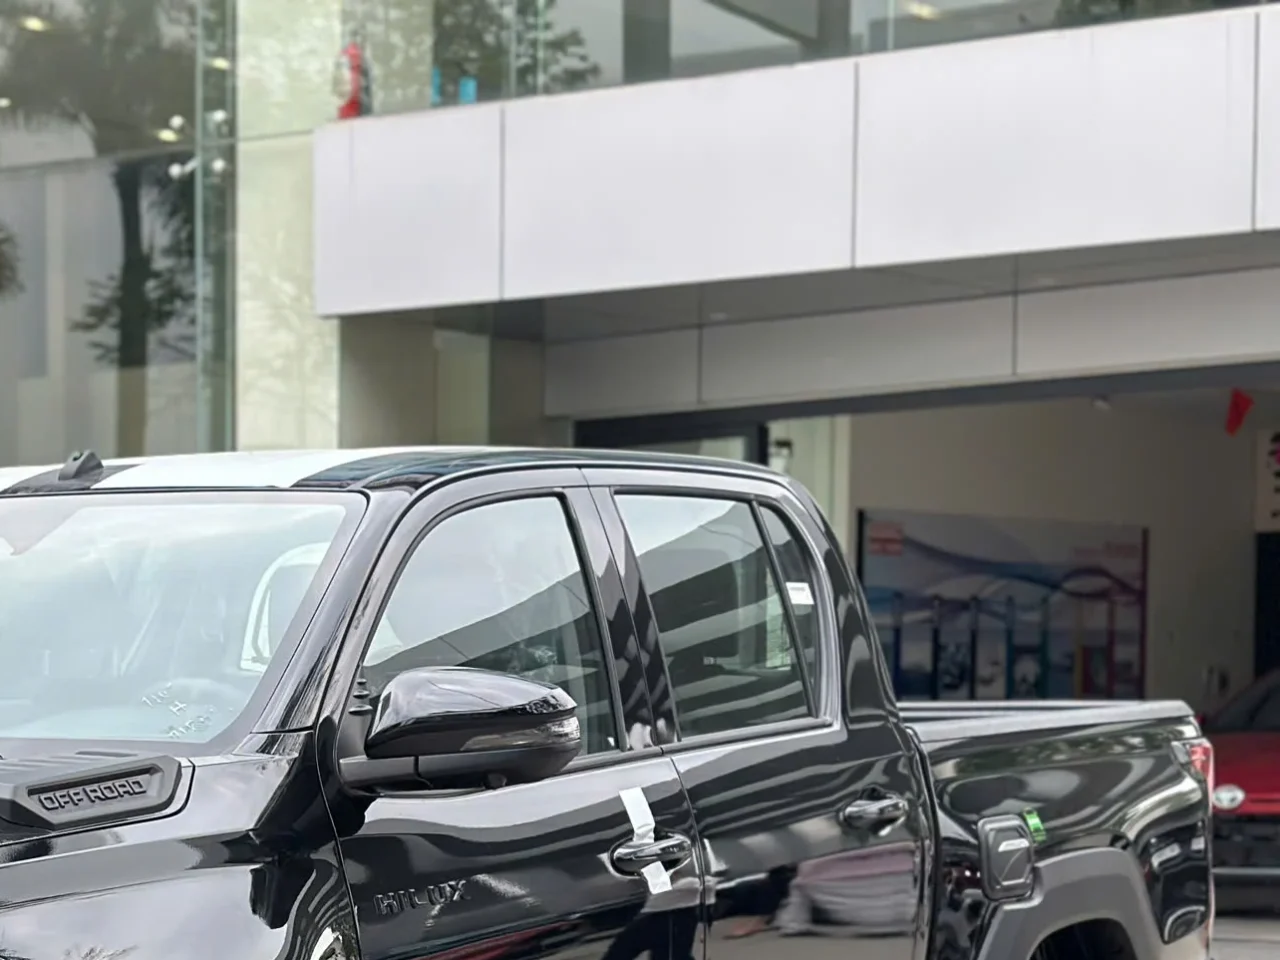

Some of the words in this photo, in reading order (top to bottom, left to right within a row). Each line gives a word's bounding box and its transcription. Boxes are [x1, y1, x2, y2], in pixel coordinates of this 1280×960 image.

[39, 790, 84, 811] OFF
[83, 780, 147, 803] ROAD
[374, 880, 470, 915] HILUX
